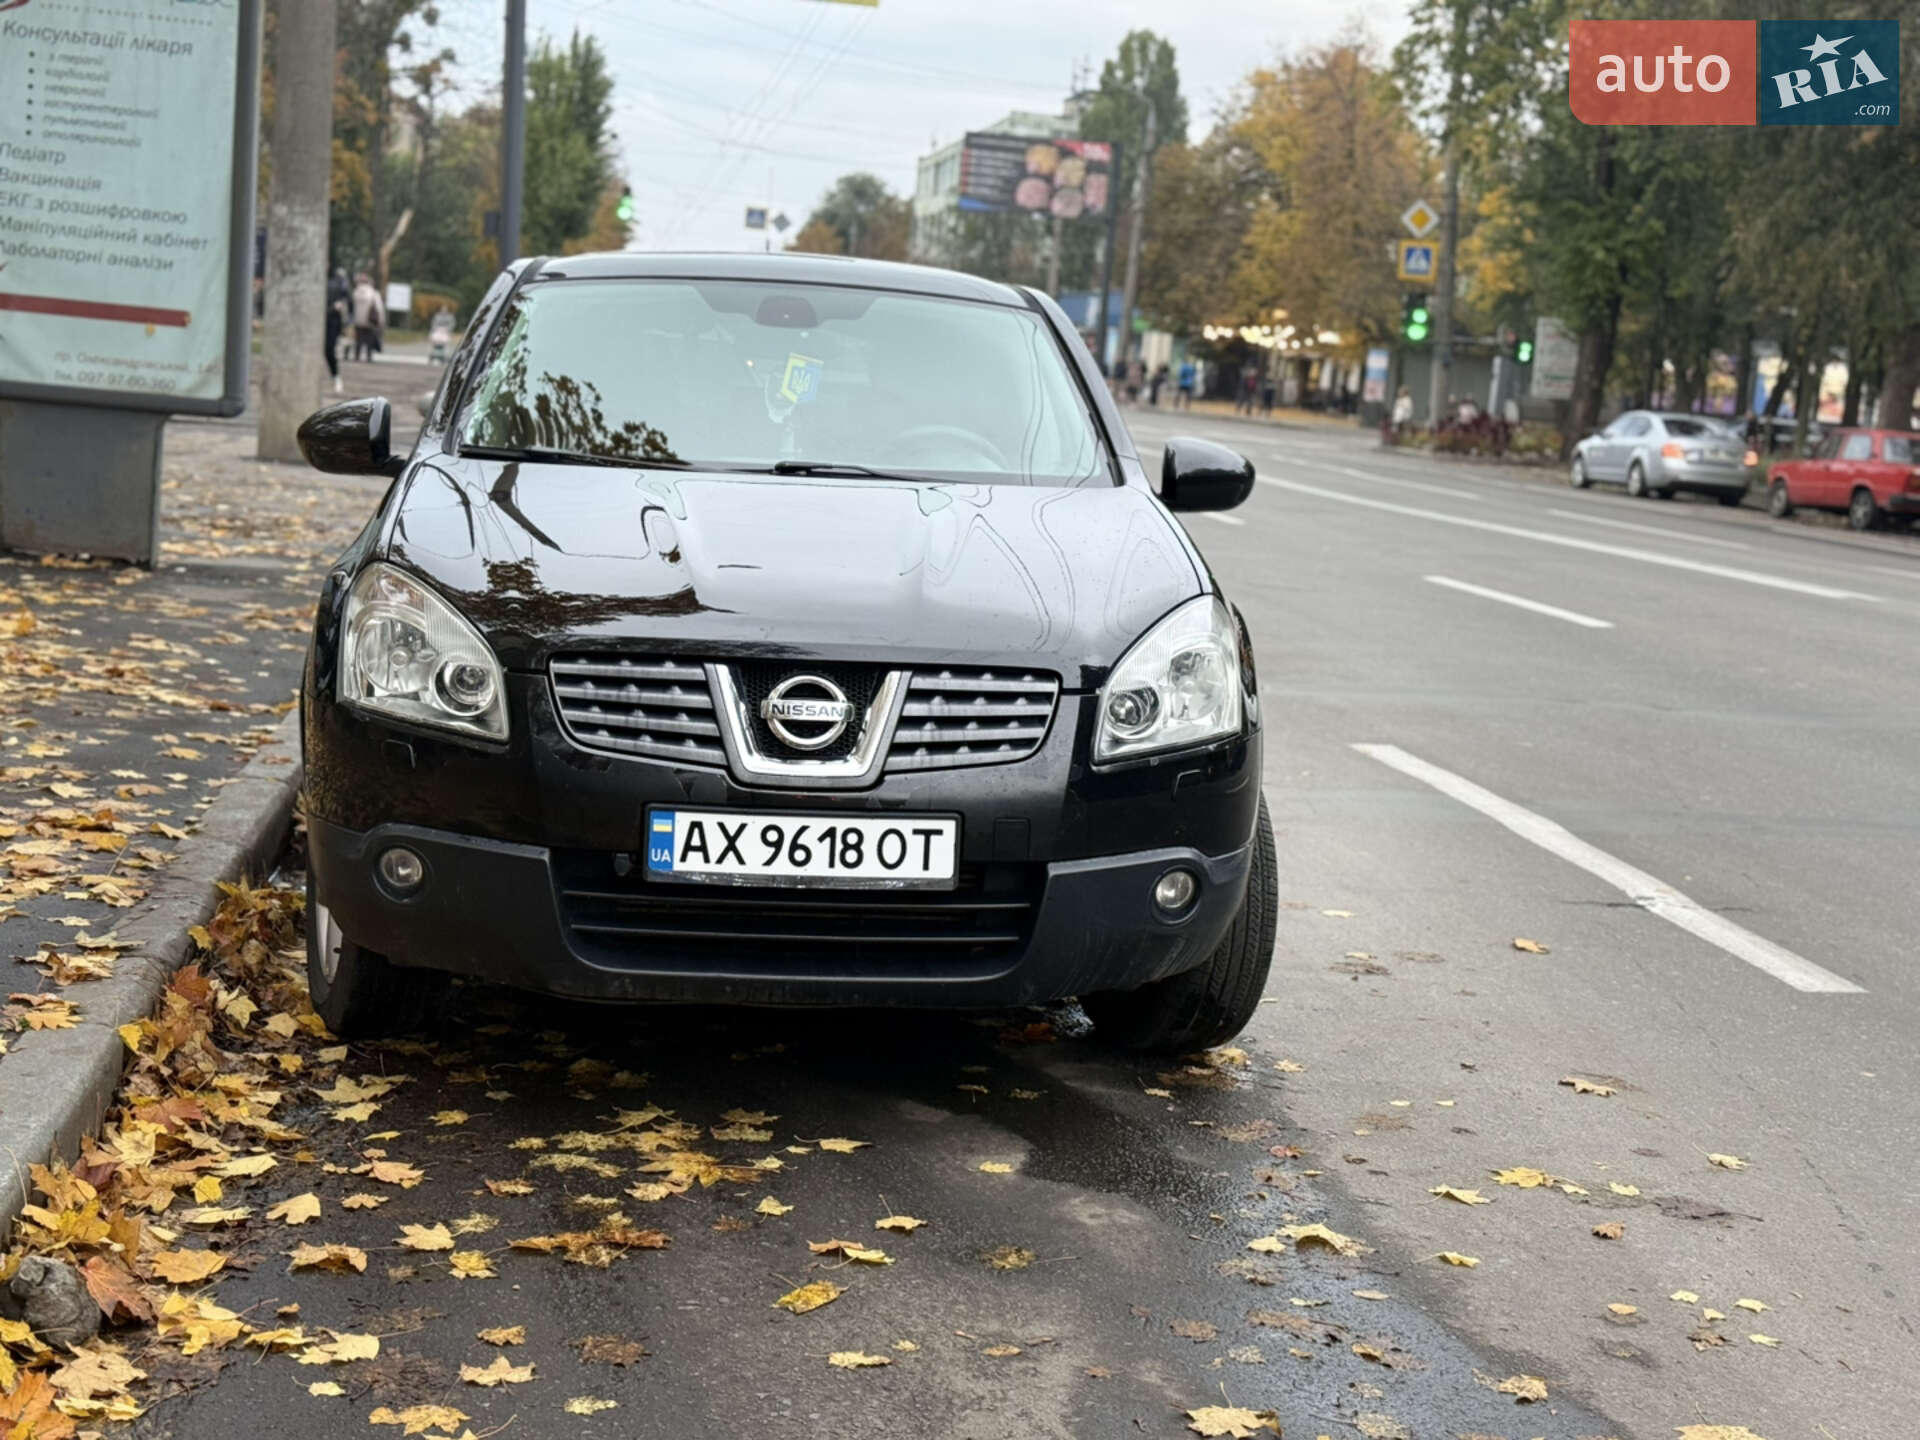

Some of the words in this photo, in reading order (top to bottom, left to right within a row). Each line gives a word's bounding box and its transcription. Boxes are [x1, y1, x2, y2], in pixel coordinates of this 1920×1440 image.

[3, 20, 125, 49] Консультації
[130, 35, 194, 57] лікаря
[48, 199, 188, 225] розшифровкою
[142, 231, 209, 251] кабінет
[107, 254, 174, 272] аналізи
[771, 703, 844, 718] NISSAN
[651, 848, 672, 863] UA
[679, 820, 748, 866] AX
[760, 823, 864, 869] 9618
[876, 828, 944, 872] OT
